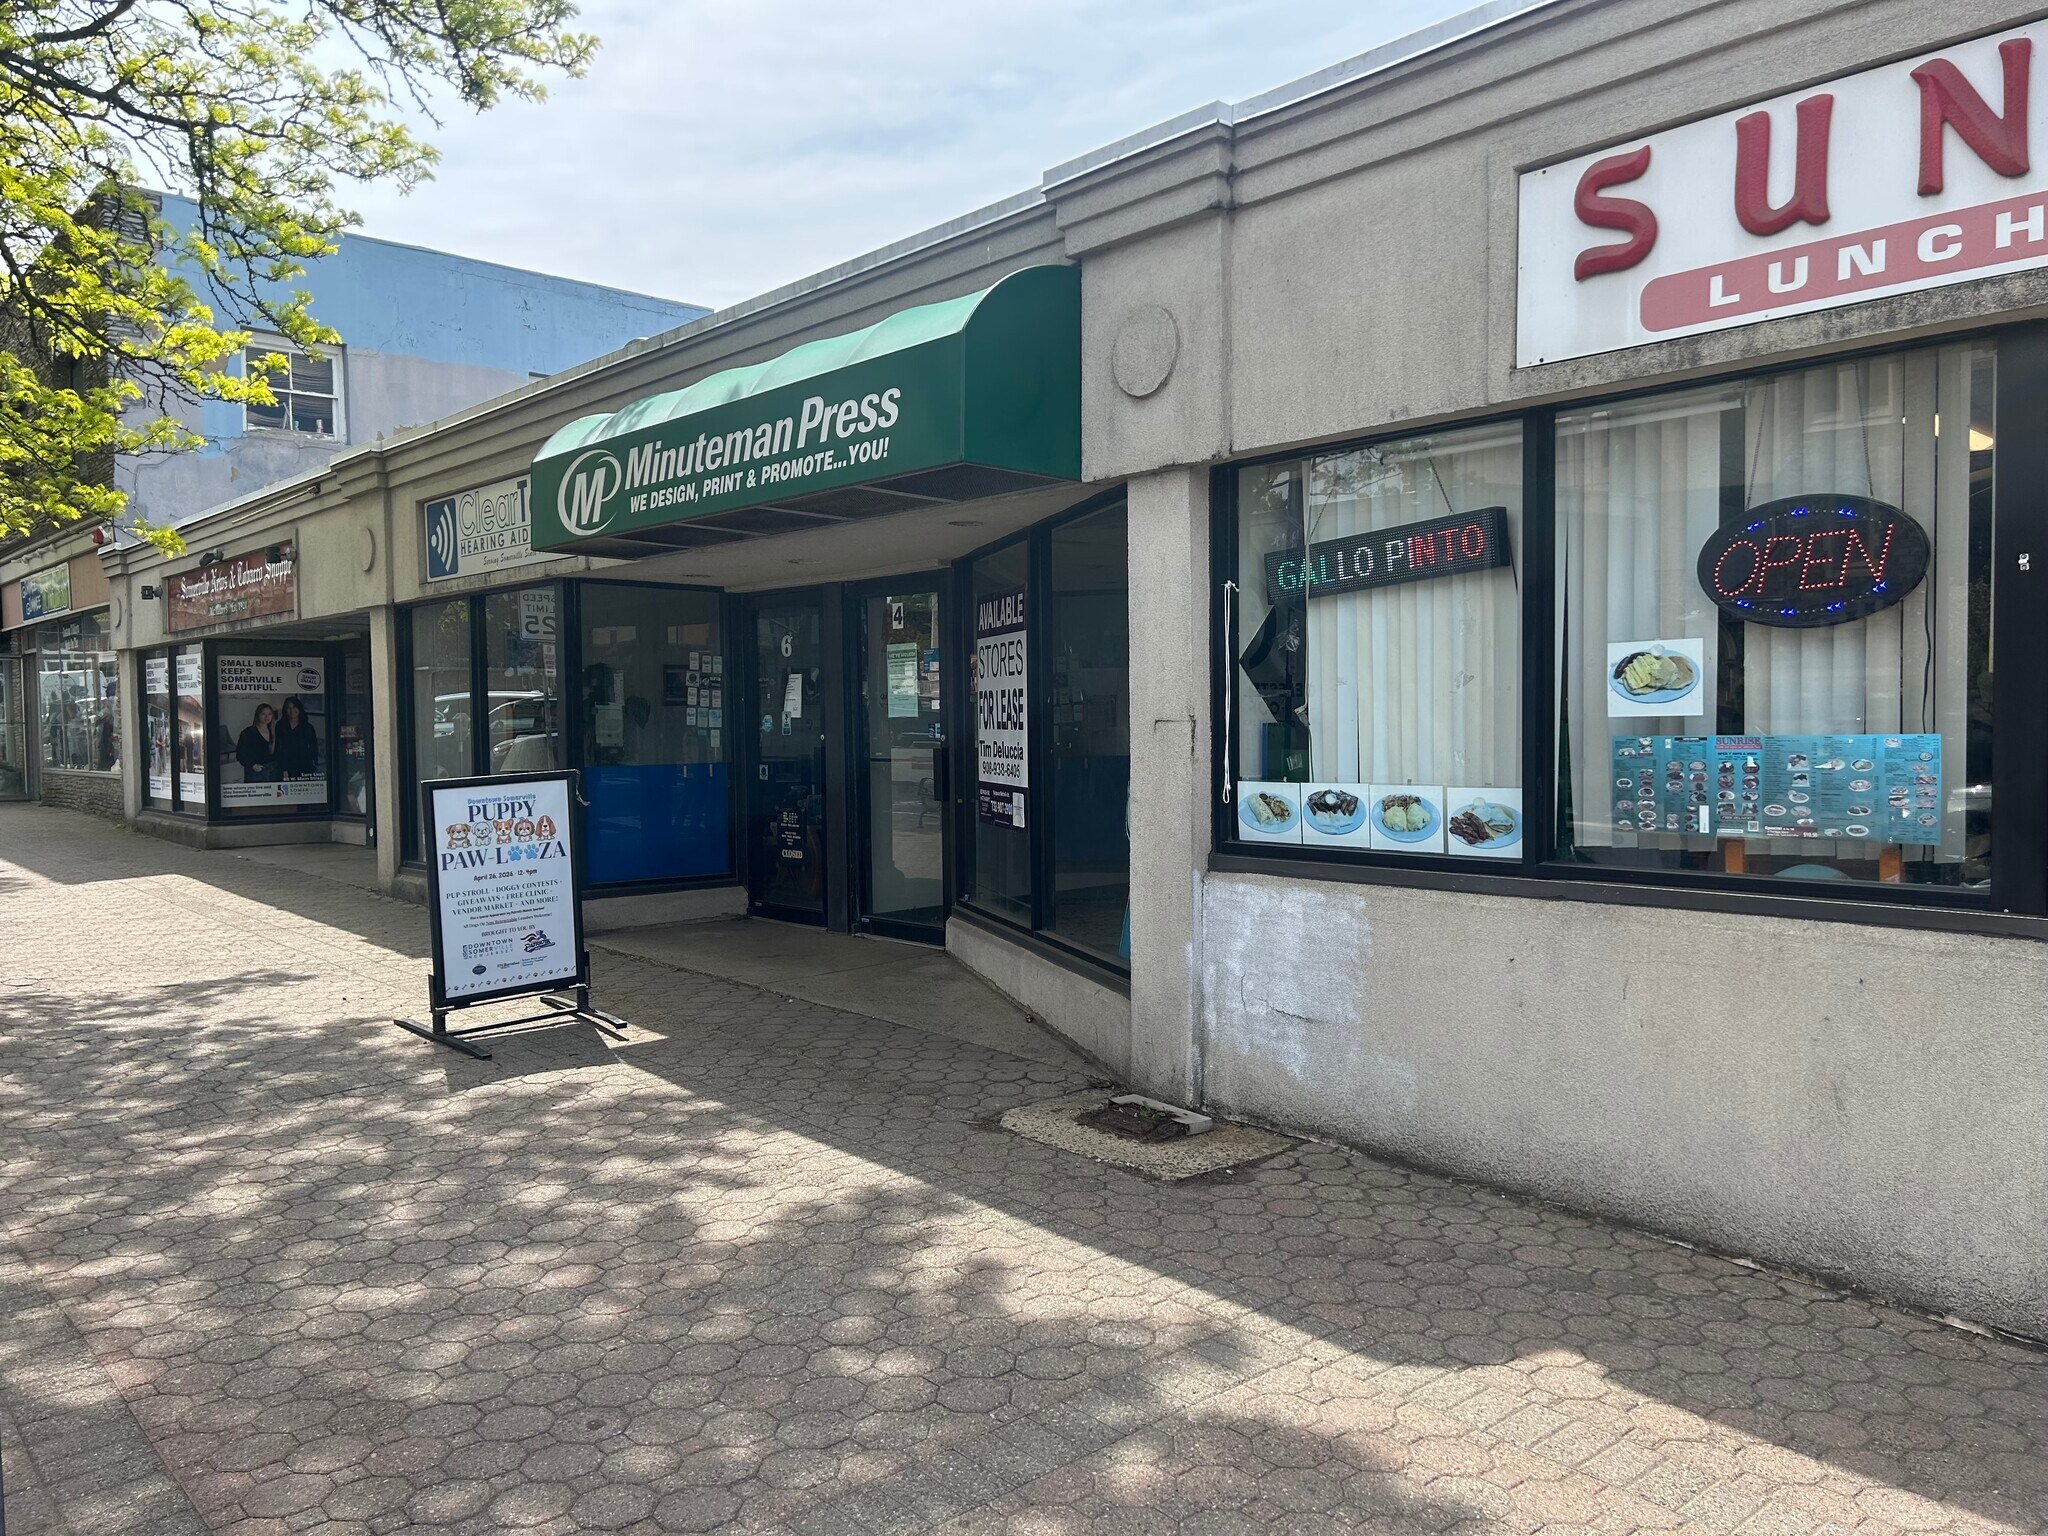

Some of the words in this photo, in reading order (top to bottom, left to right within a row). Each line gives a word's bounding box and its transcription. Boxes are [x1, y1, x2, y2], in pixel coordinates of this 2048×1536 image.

[1573, 37, 2032, 281] SUN
[1708, 204, 2046, 308] LUNCH
[624, 415, 795, 491] Minuteman
[800, 387, 901, 447] Press
[629, 492, 647, 513] WE
[649, 485, 700, 510] DESIGN,
[702, 471, 744, 498] PRINT
[747, 469, 757, 488] &
[460, 533, 505, 556] HEARING
[510, 528, 529, 546] AID
[483, 556, 499, 566] Serving
[500, 552, 523, 562] Somerville
[1277, 546, 1374, 590] GALLO
[1385, 524, 1485, 572] PINTO
[1713, 522, 1895, 597] OPEN
[893, 605, 903, 625] 4
[978, 592, 1024, 631] AVAILABLE
[780, 634, 793, 658] 6
[220, 659, 254, 667] SMALL
[255, 660, 303, 668] BUSINESS
[979, 639, 1024, 680] STORES
[220, 676, 282, 684] SOMERVILLE
[979, 689, 995, 730] FOR
[996, 687, 1024, 731] LEASE
[979, 740, 992, 758] Tim
[1715, 736, 1761, 745] SUNRISE
[468, 795, 502, 805] Downtown
[503, 793, 537, 802] Somerville
[468, 800, 537, 822] PUPPY
[474, 874, 488, 882] April
[499, 871, 514, 879] 2026
[446, 891, 461, 899] PUP
[462, 888, 489, 896] STROLL
[495, 884, 521, 893] DOGGY
[521, 879, 559, 889] CONTESTS
[457, 895, 501, 906] GIVEAWAYS
[506, 892, 523, 900] FREE
[525, 889, 549, 898] CLINIC
[452, 905, 482, 916] VENDOR
[483, 901, 514, 911] MARKET
[521, 898, 535, 906] AND
[536, 895, 559, 904] MORE!
[481, 929, 507, 937] BROUGHT
[468, 938, 513, 950] DOWNTOWN
[469, 943, 513, 955] SOMERVILLE
